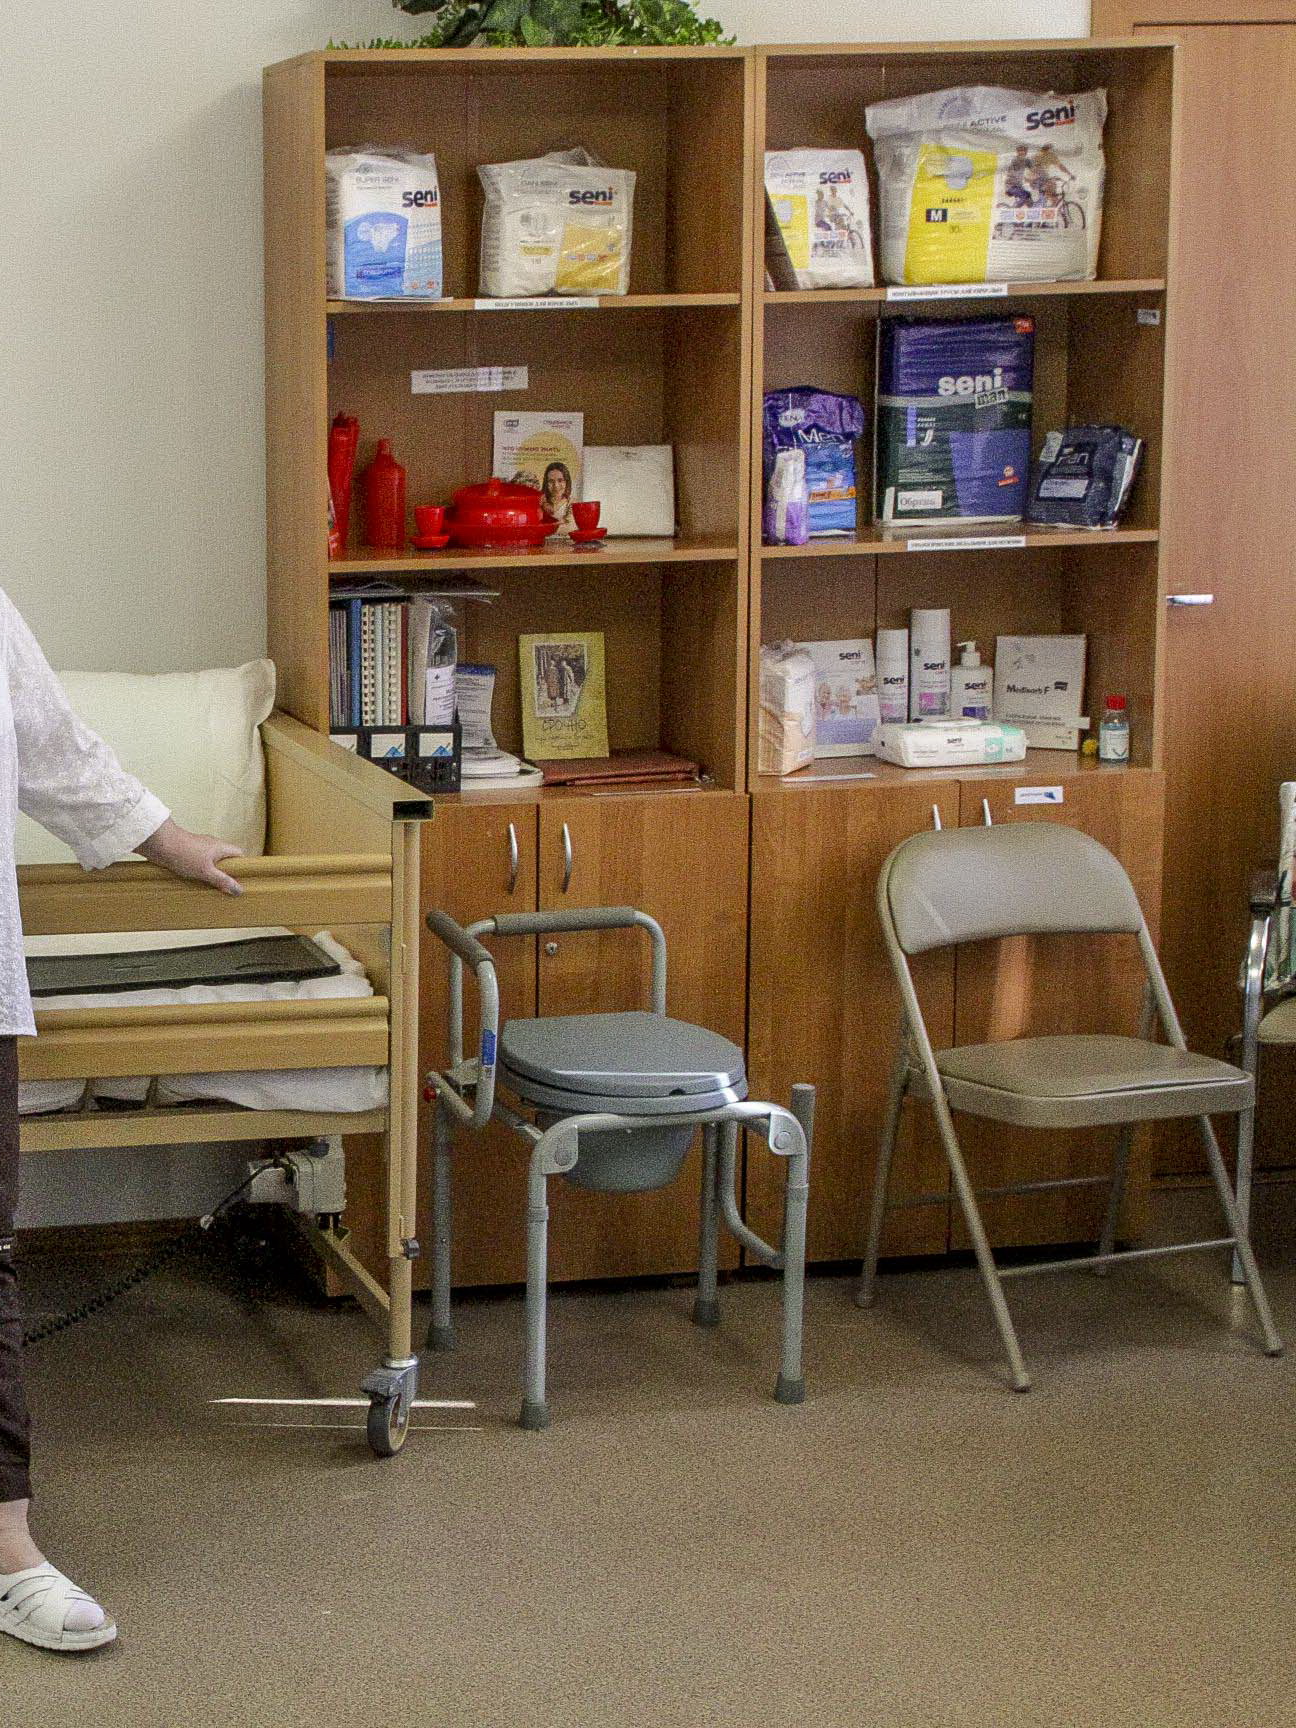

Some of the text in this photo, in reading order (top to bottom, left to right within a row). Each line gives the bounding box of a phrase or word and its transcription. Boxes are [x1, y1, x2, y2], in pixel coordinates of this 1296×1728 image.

[970, 115, 1007, 127] ACTIVE
[1026, 99, 1076, 131] seni
[819, 167, 852, 184] seni
[402, 186, 438, 208] seni
[568, 186, 614, 206] seni
[930, 210, 943, 221] M
[938, 367, 1004, 396] seni
[977, 390, 1007, 406] man
[797, 427, 845, 444] Men
[839, 650, 862, 661] seni
[923, 660, 946, 671] seni
[883, 675, 905, 685] seni
[964, 681, 987, 690] seni
[1043, 685, 1051, 695] F
